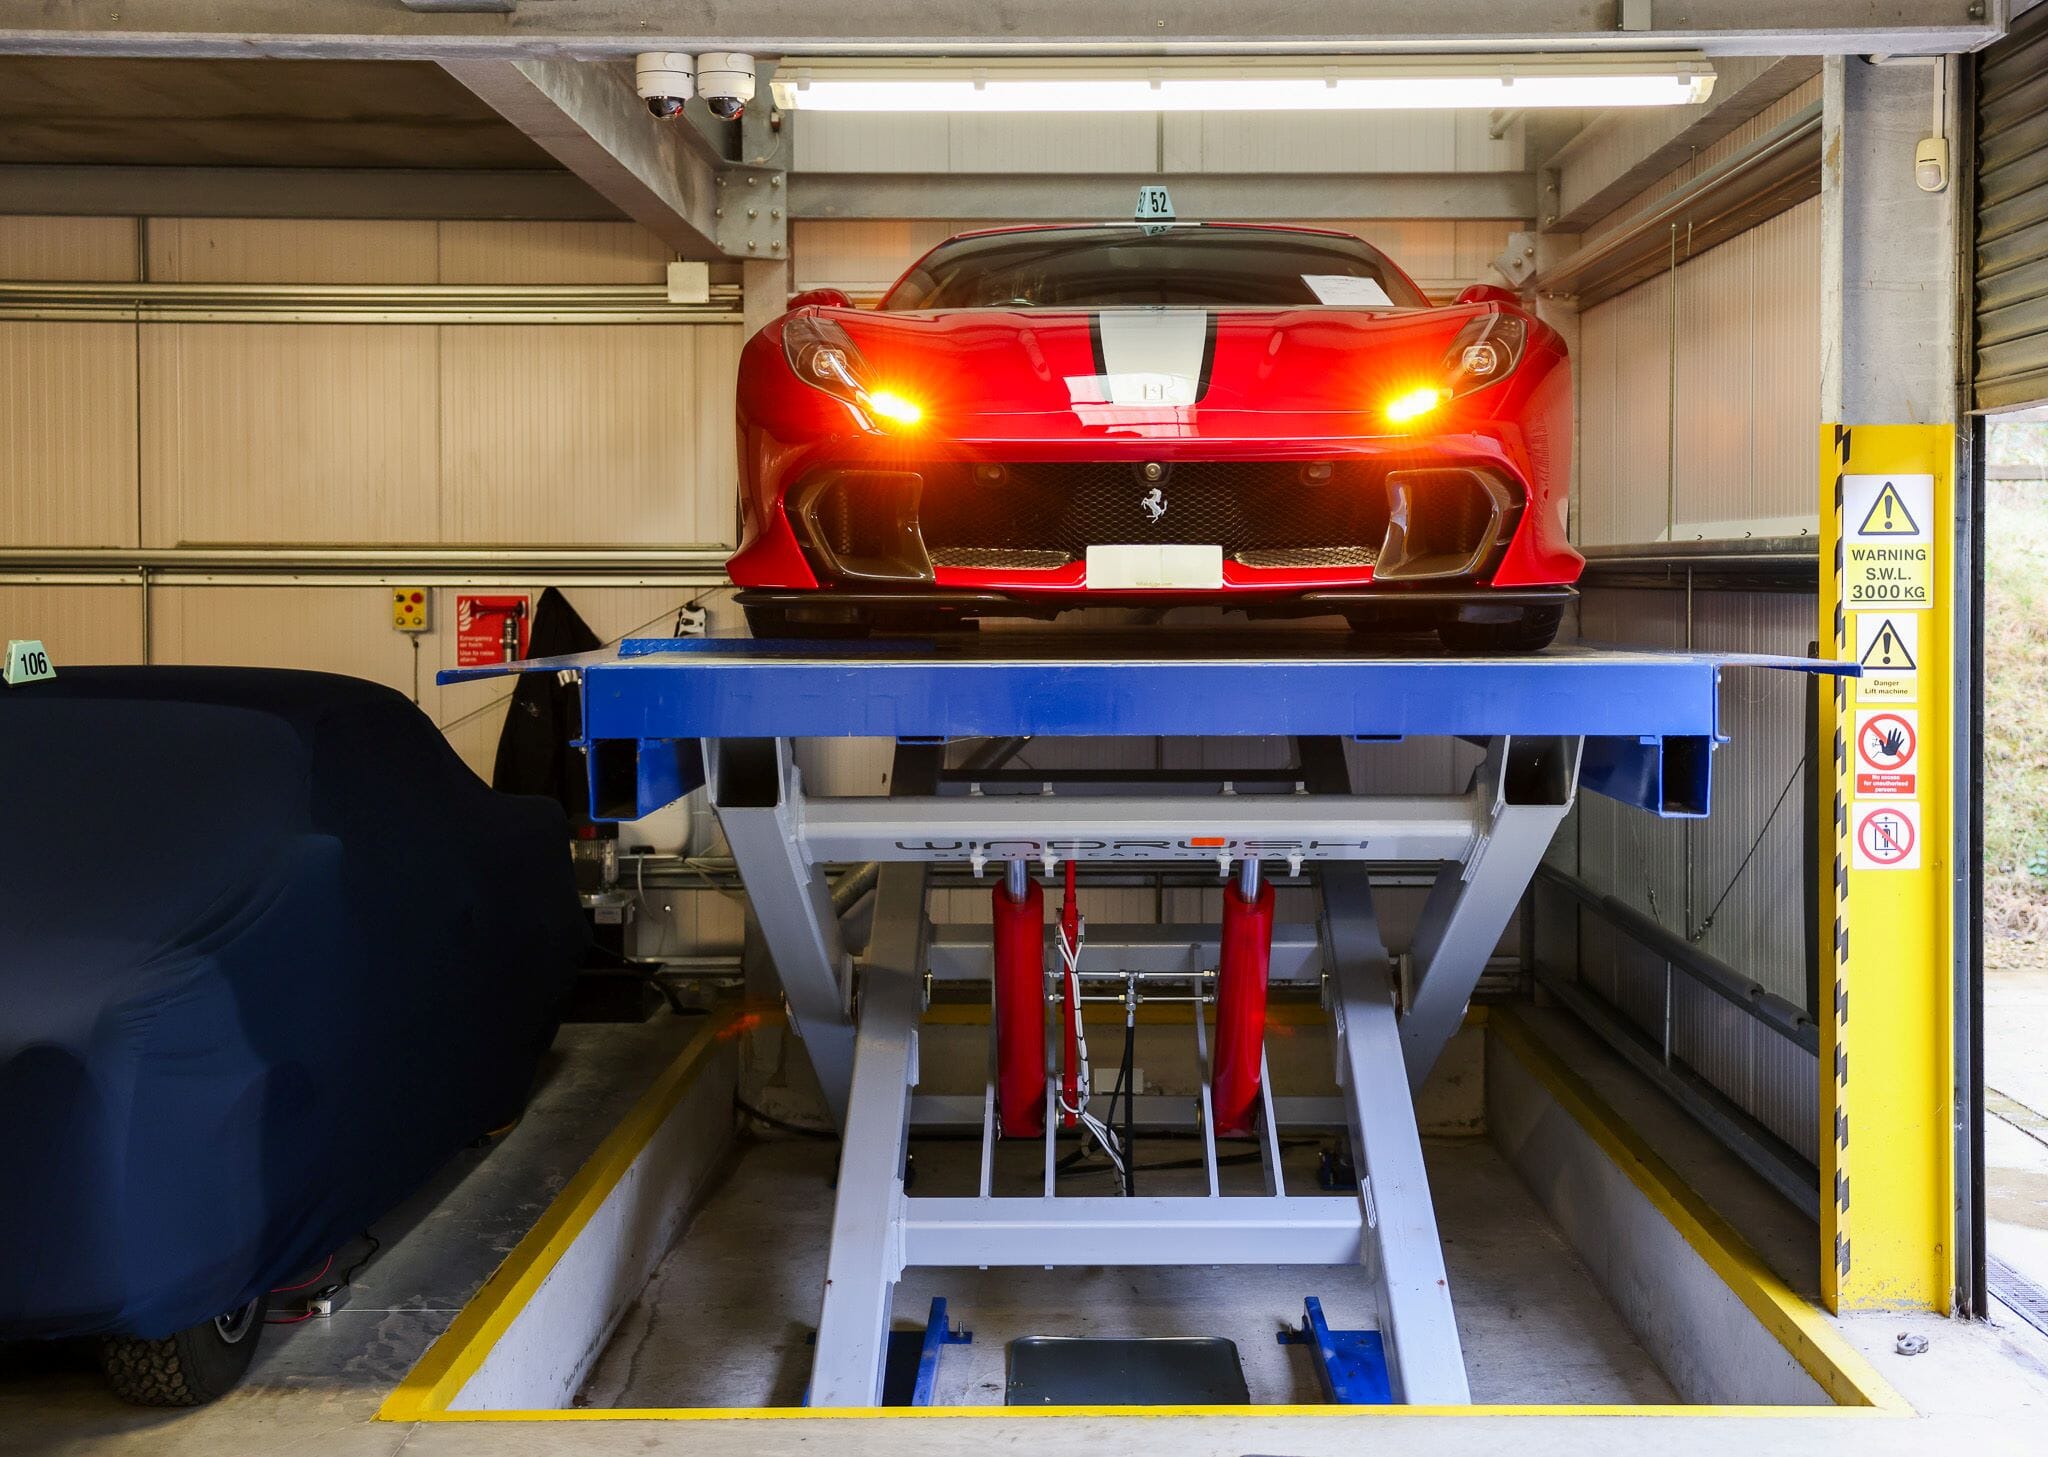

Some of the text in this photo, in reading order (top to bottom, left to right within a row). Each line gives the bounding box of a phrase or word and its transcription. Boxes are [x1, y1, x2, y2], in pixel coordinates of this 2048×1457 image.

[1150, 191, 1168, 213] 52
[1851, 548, 1927, 561] WARNING
[1865, 567, 1912, 581] S.W.L.
[1852, 584, 1926, 599] 3000 KG
[20, 651, 48, 676] 106
[1873, 679, 1900, 688] Danger
[895, 837, 1369, 851] WINDRUSH
